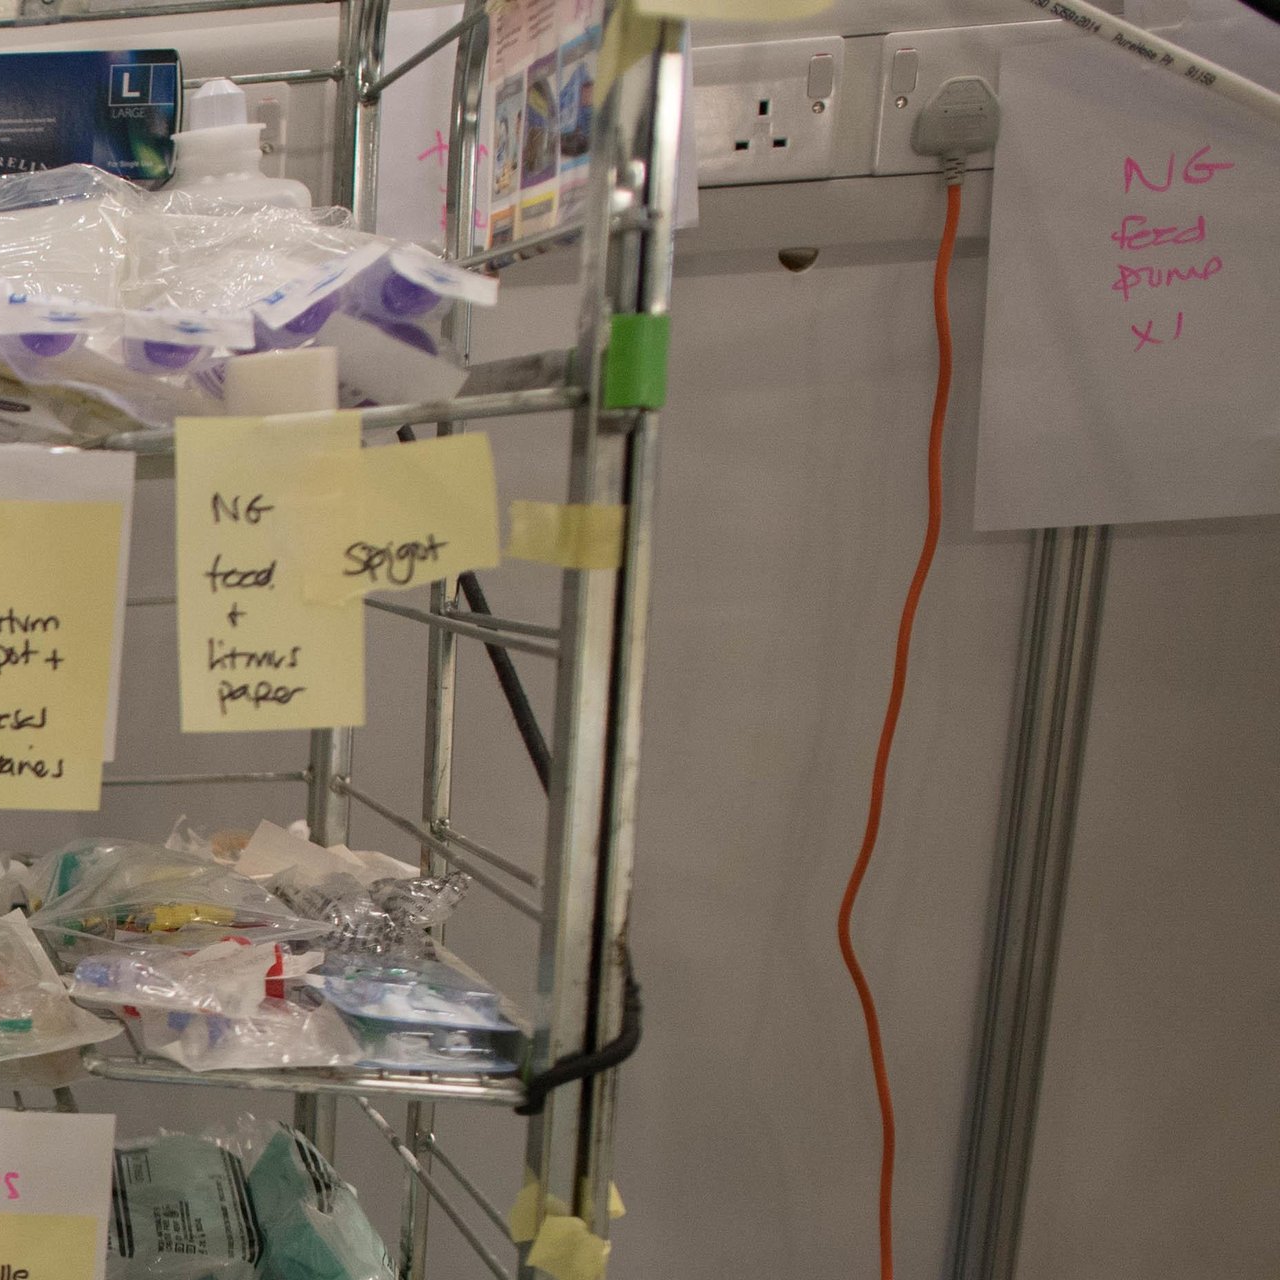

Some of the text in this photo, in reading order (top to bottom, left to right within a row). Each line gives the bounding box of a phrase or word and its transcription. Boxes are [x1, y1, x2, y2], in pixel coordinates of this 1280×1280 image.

[122, 72, 141, 97] L
[112, 107, 146, 119] LARGE
[1123, 145, 1235, 194] NG
[1111, 255, 1223, 302] pump
[211, 492, 275, 525] NG
